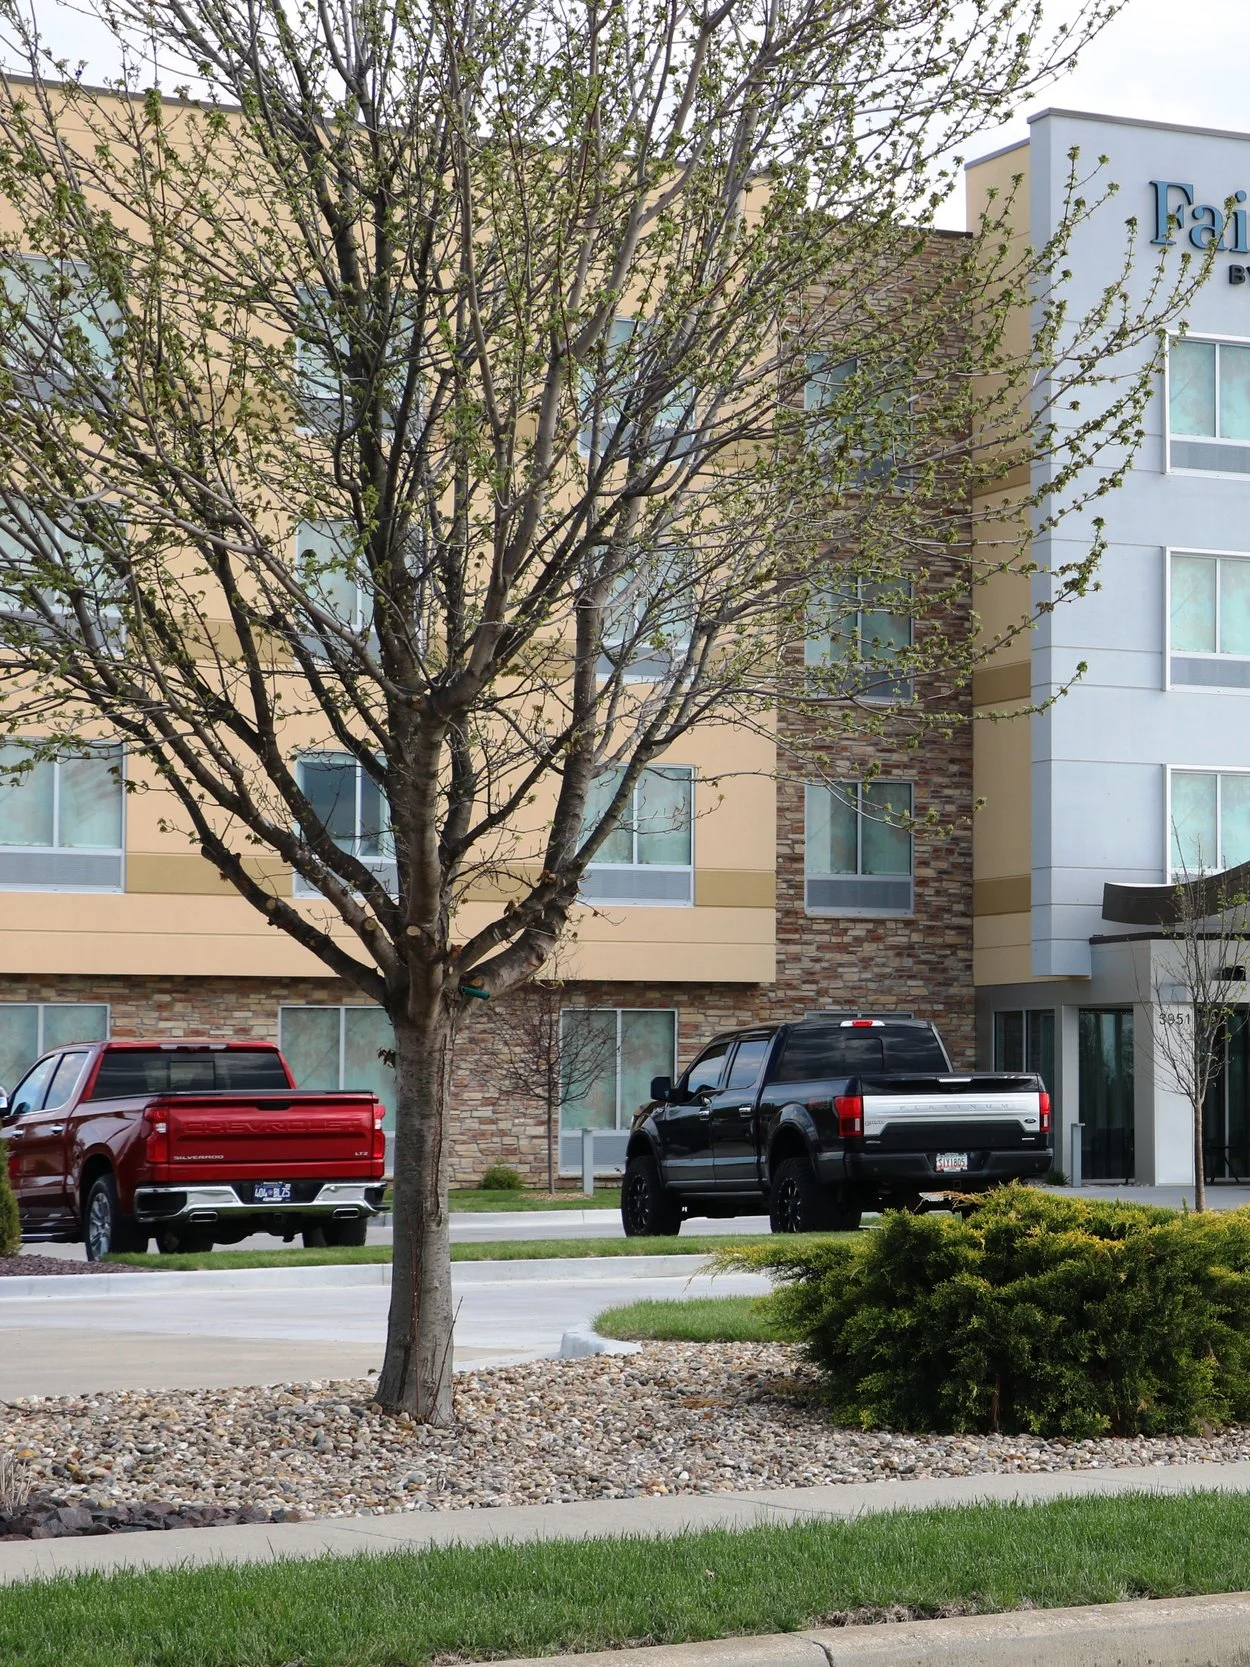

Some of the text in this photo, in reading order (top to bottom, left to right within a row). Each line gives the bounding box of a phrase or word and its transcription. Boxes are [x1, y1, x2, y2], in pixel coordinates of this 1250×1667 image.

[1159, 1013, 1190, 1025] 3951
[899, 1103, 1009, 1112] PLATINUM
[185, 1120, 360, 1133] CHEVROLET
